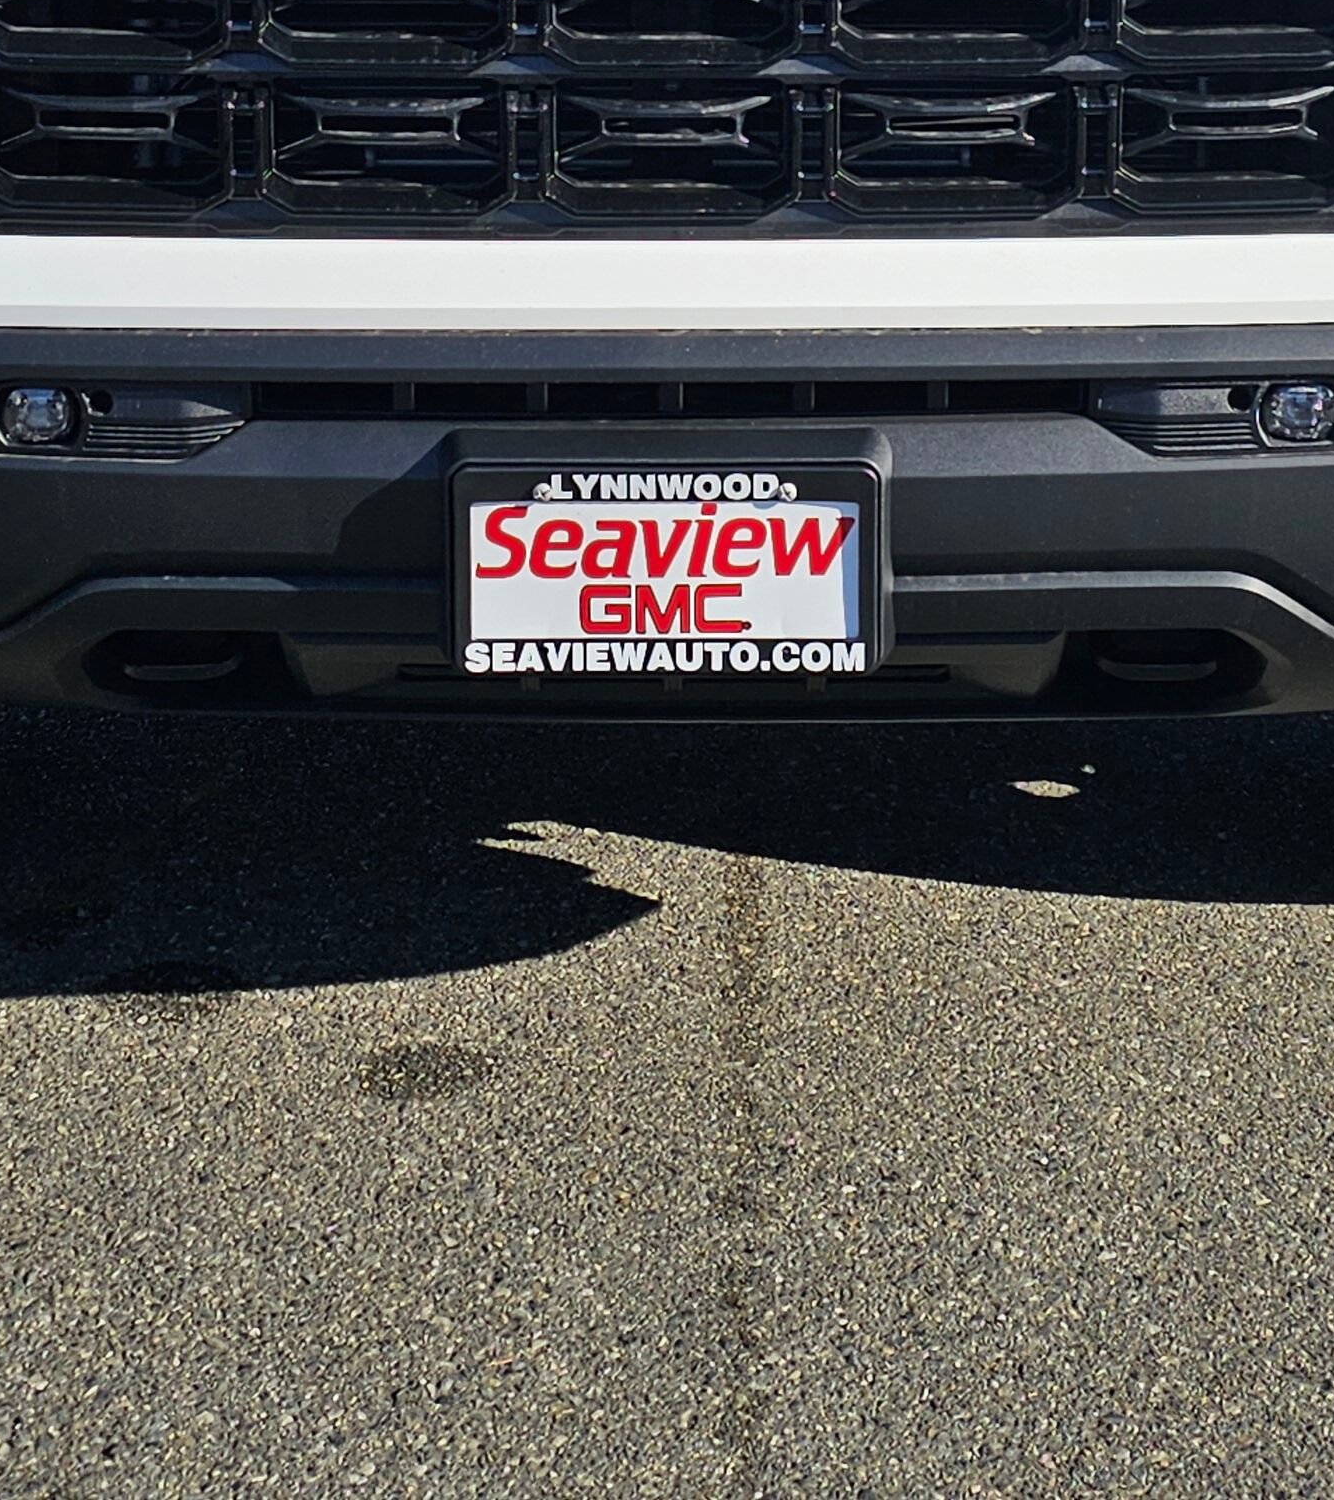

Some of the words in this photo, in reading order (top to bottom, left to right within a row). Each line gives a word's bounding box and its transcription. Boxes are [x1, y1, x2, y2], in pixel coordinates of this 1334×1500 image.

[551, 473, 780, 501] LYNNWOOD
[474, 502, 856, 579] Seaview
[579, 583, 745, 635] GMC
[464, 641, 866, 674] SEAVIEWAUTO.COM
